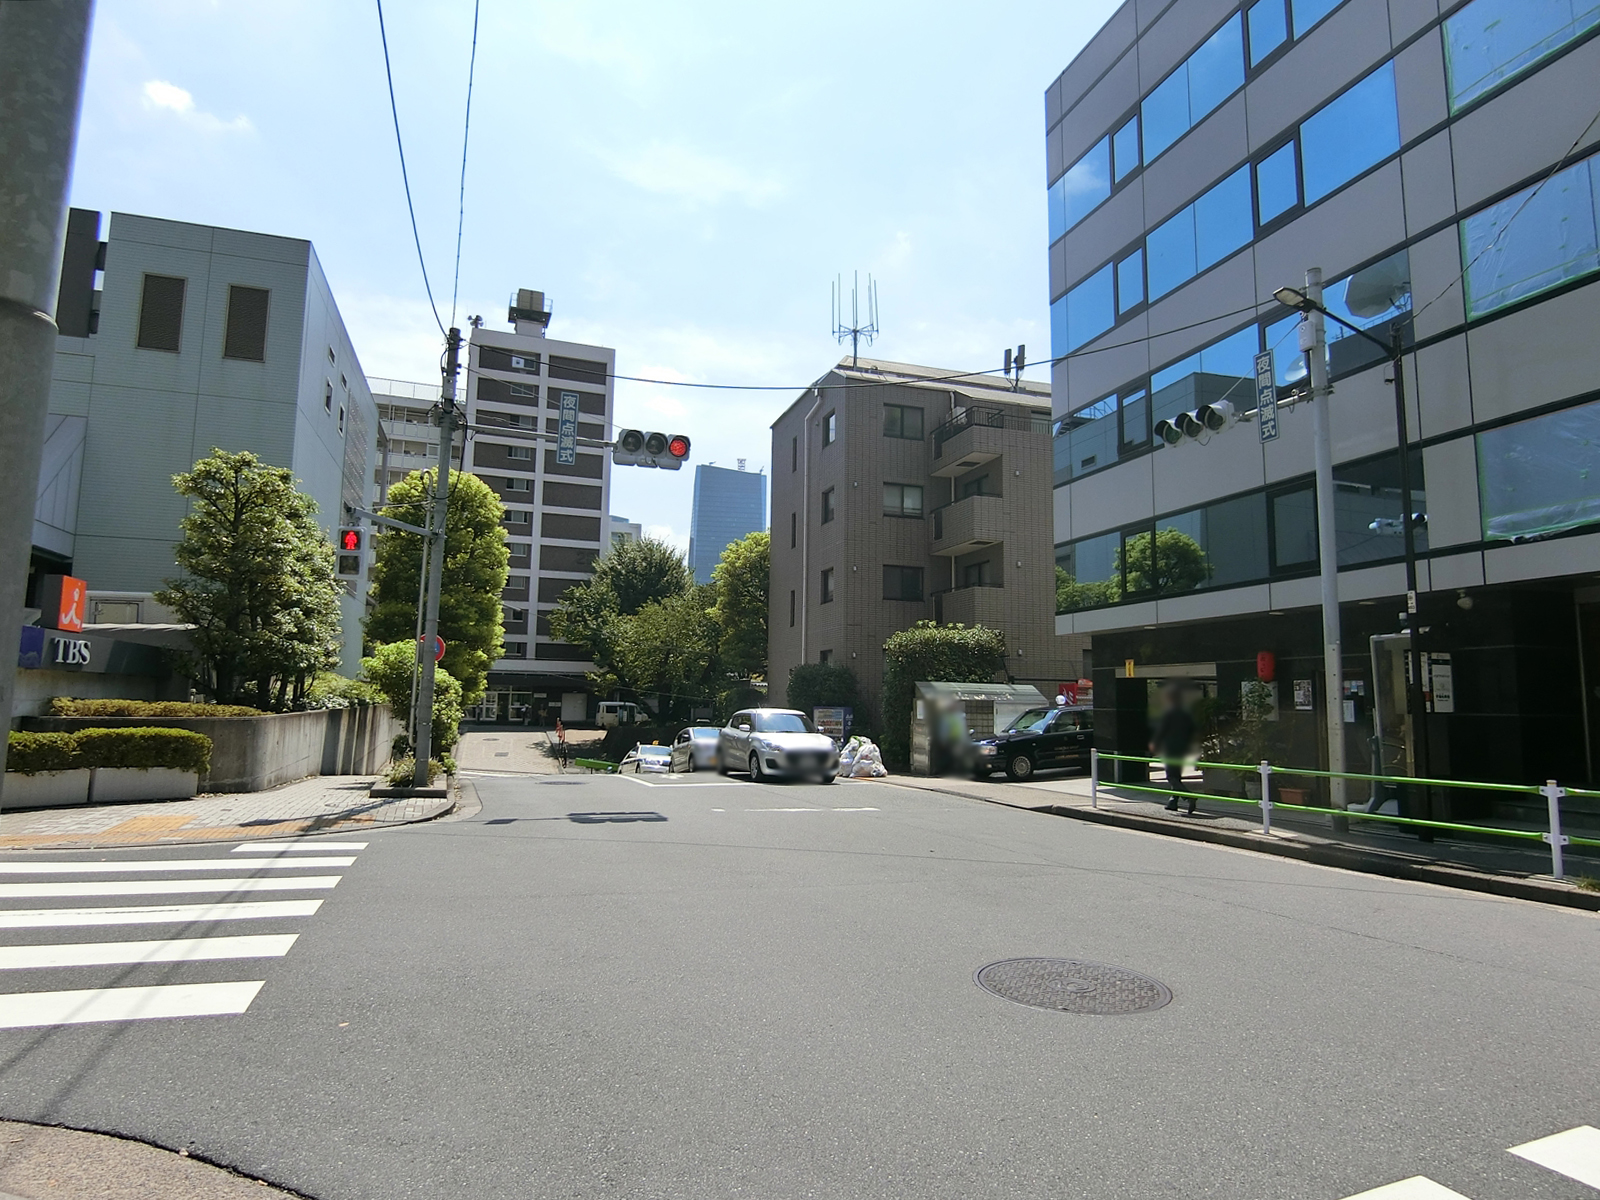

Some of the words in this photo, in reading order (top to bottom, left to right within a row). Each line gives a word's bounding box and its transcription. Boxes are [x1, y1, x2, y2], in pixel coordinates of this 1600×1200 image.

[560, 395, 577, 463] 夜間点滅式
[1256, 355, 1276, 439] 夜間点滅式
[54, 637, 92, 665] TBS
